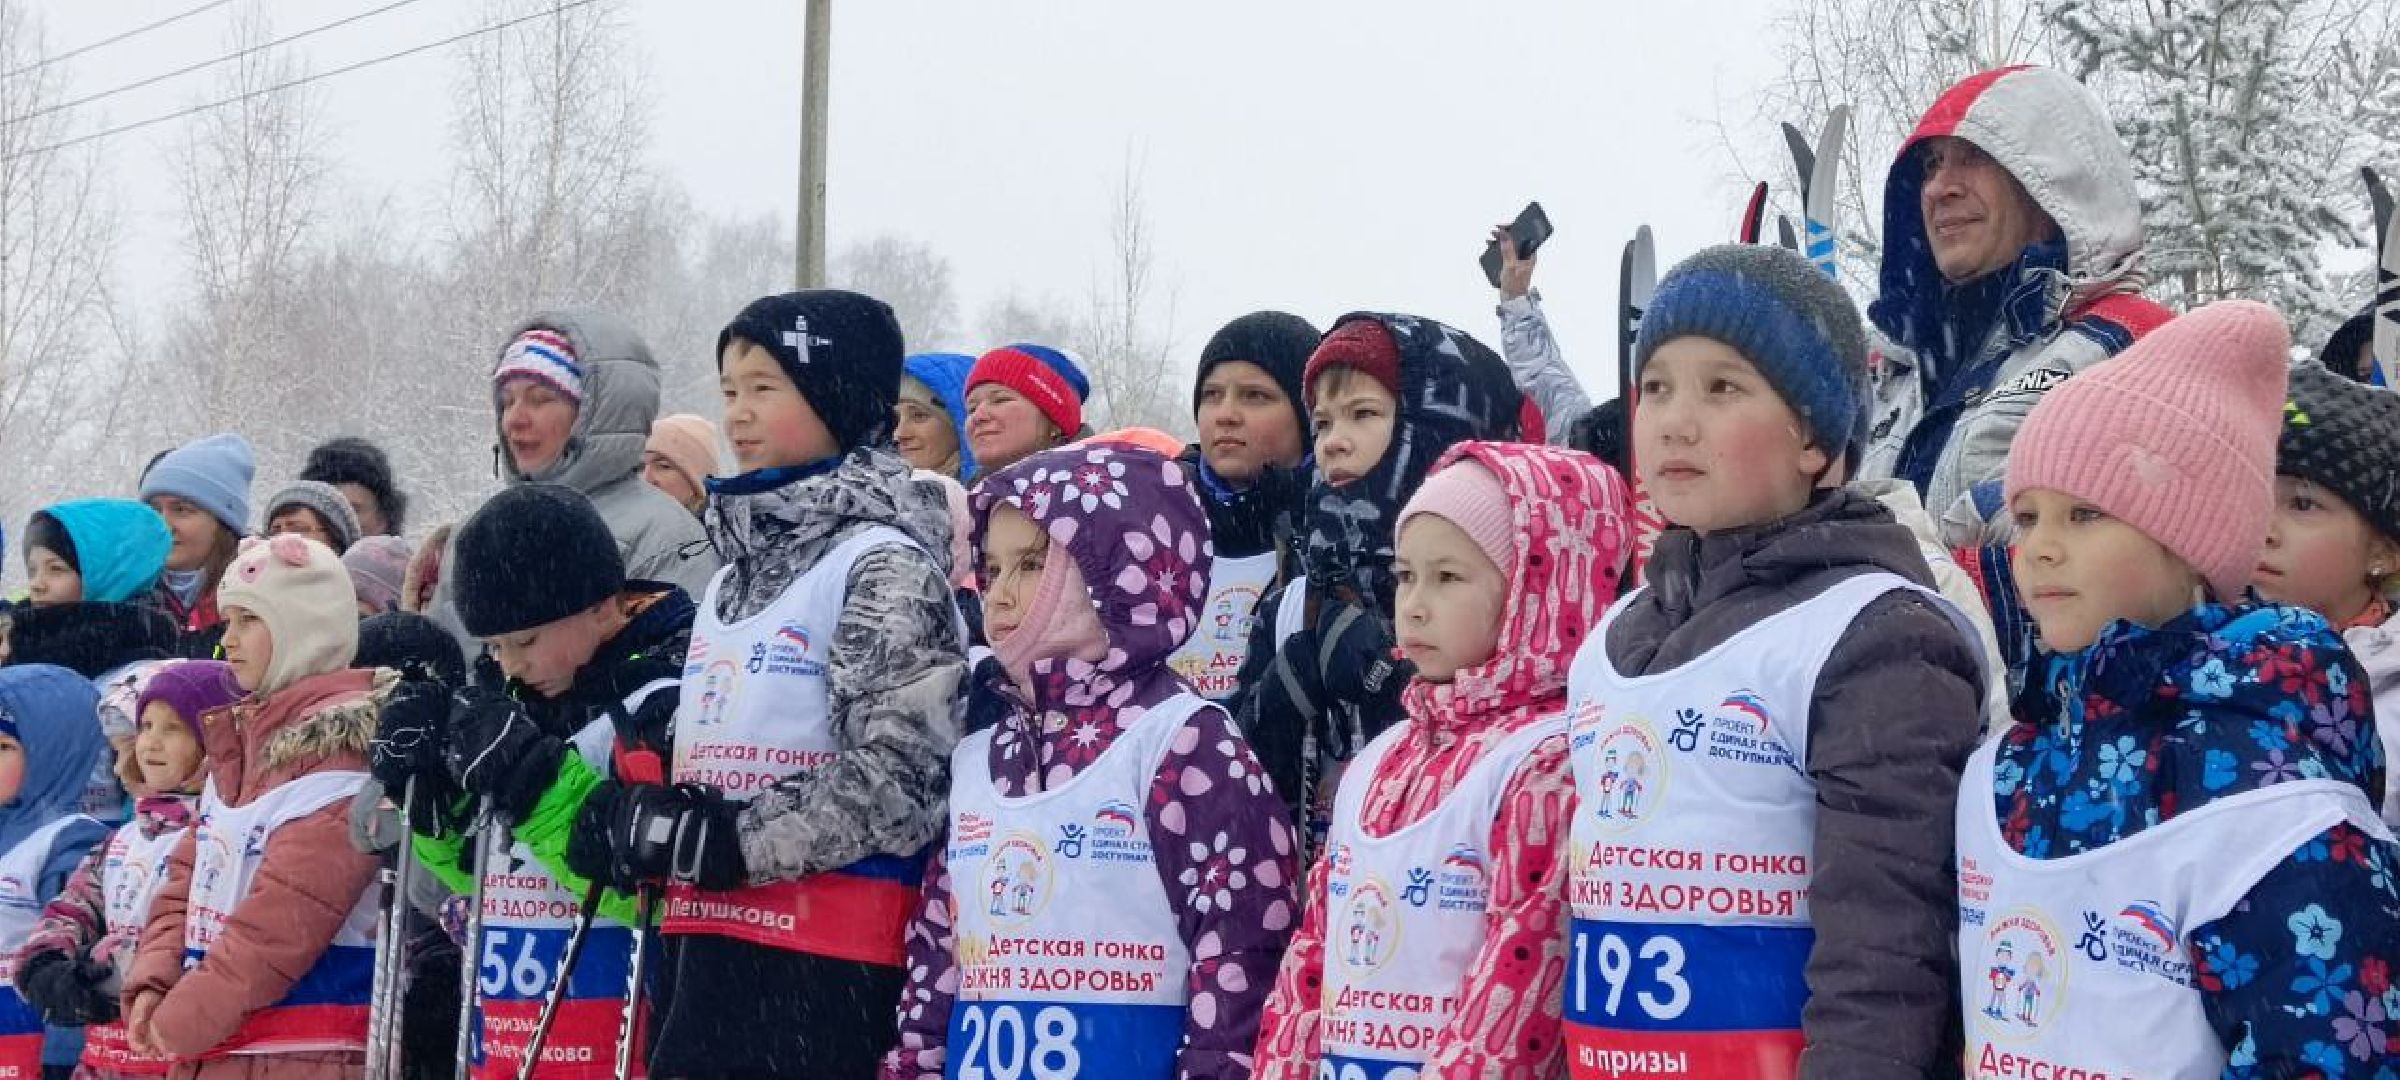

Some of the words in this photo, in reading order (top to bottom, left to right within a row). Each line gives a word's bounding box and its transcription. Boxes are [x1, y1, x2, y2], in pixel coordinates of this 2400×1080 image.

[1590, 840, 1703, 870] Детская
[1714, 853, 1806, 875] гонка
[988, 932, 1085, 958] Детская
[1094, 940, 1165, 961] гонка
[1575, 932, 1692, 1021] 193
[1336, 984, 1433, 1013] Детская
[958, 1005, 1081, 1080] 208
[1362, 1022, 1436, 1051] ЗДОР
[1597, 1049, 1688, 1079] призы
